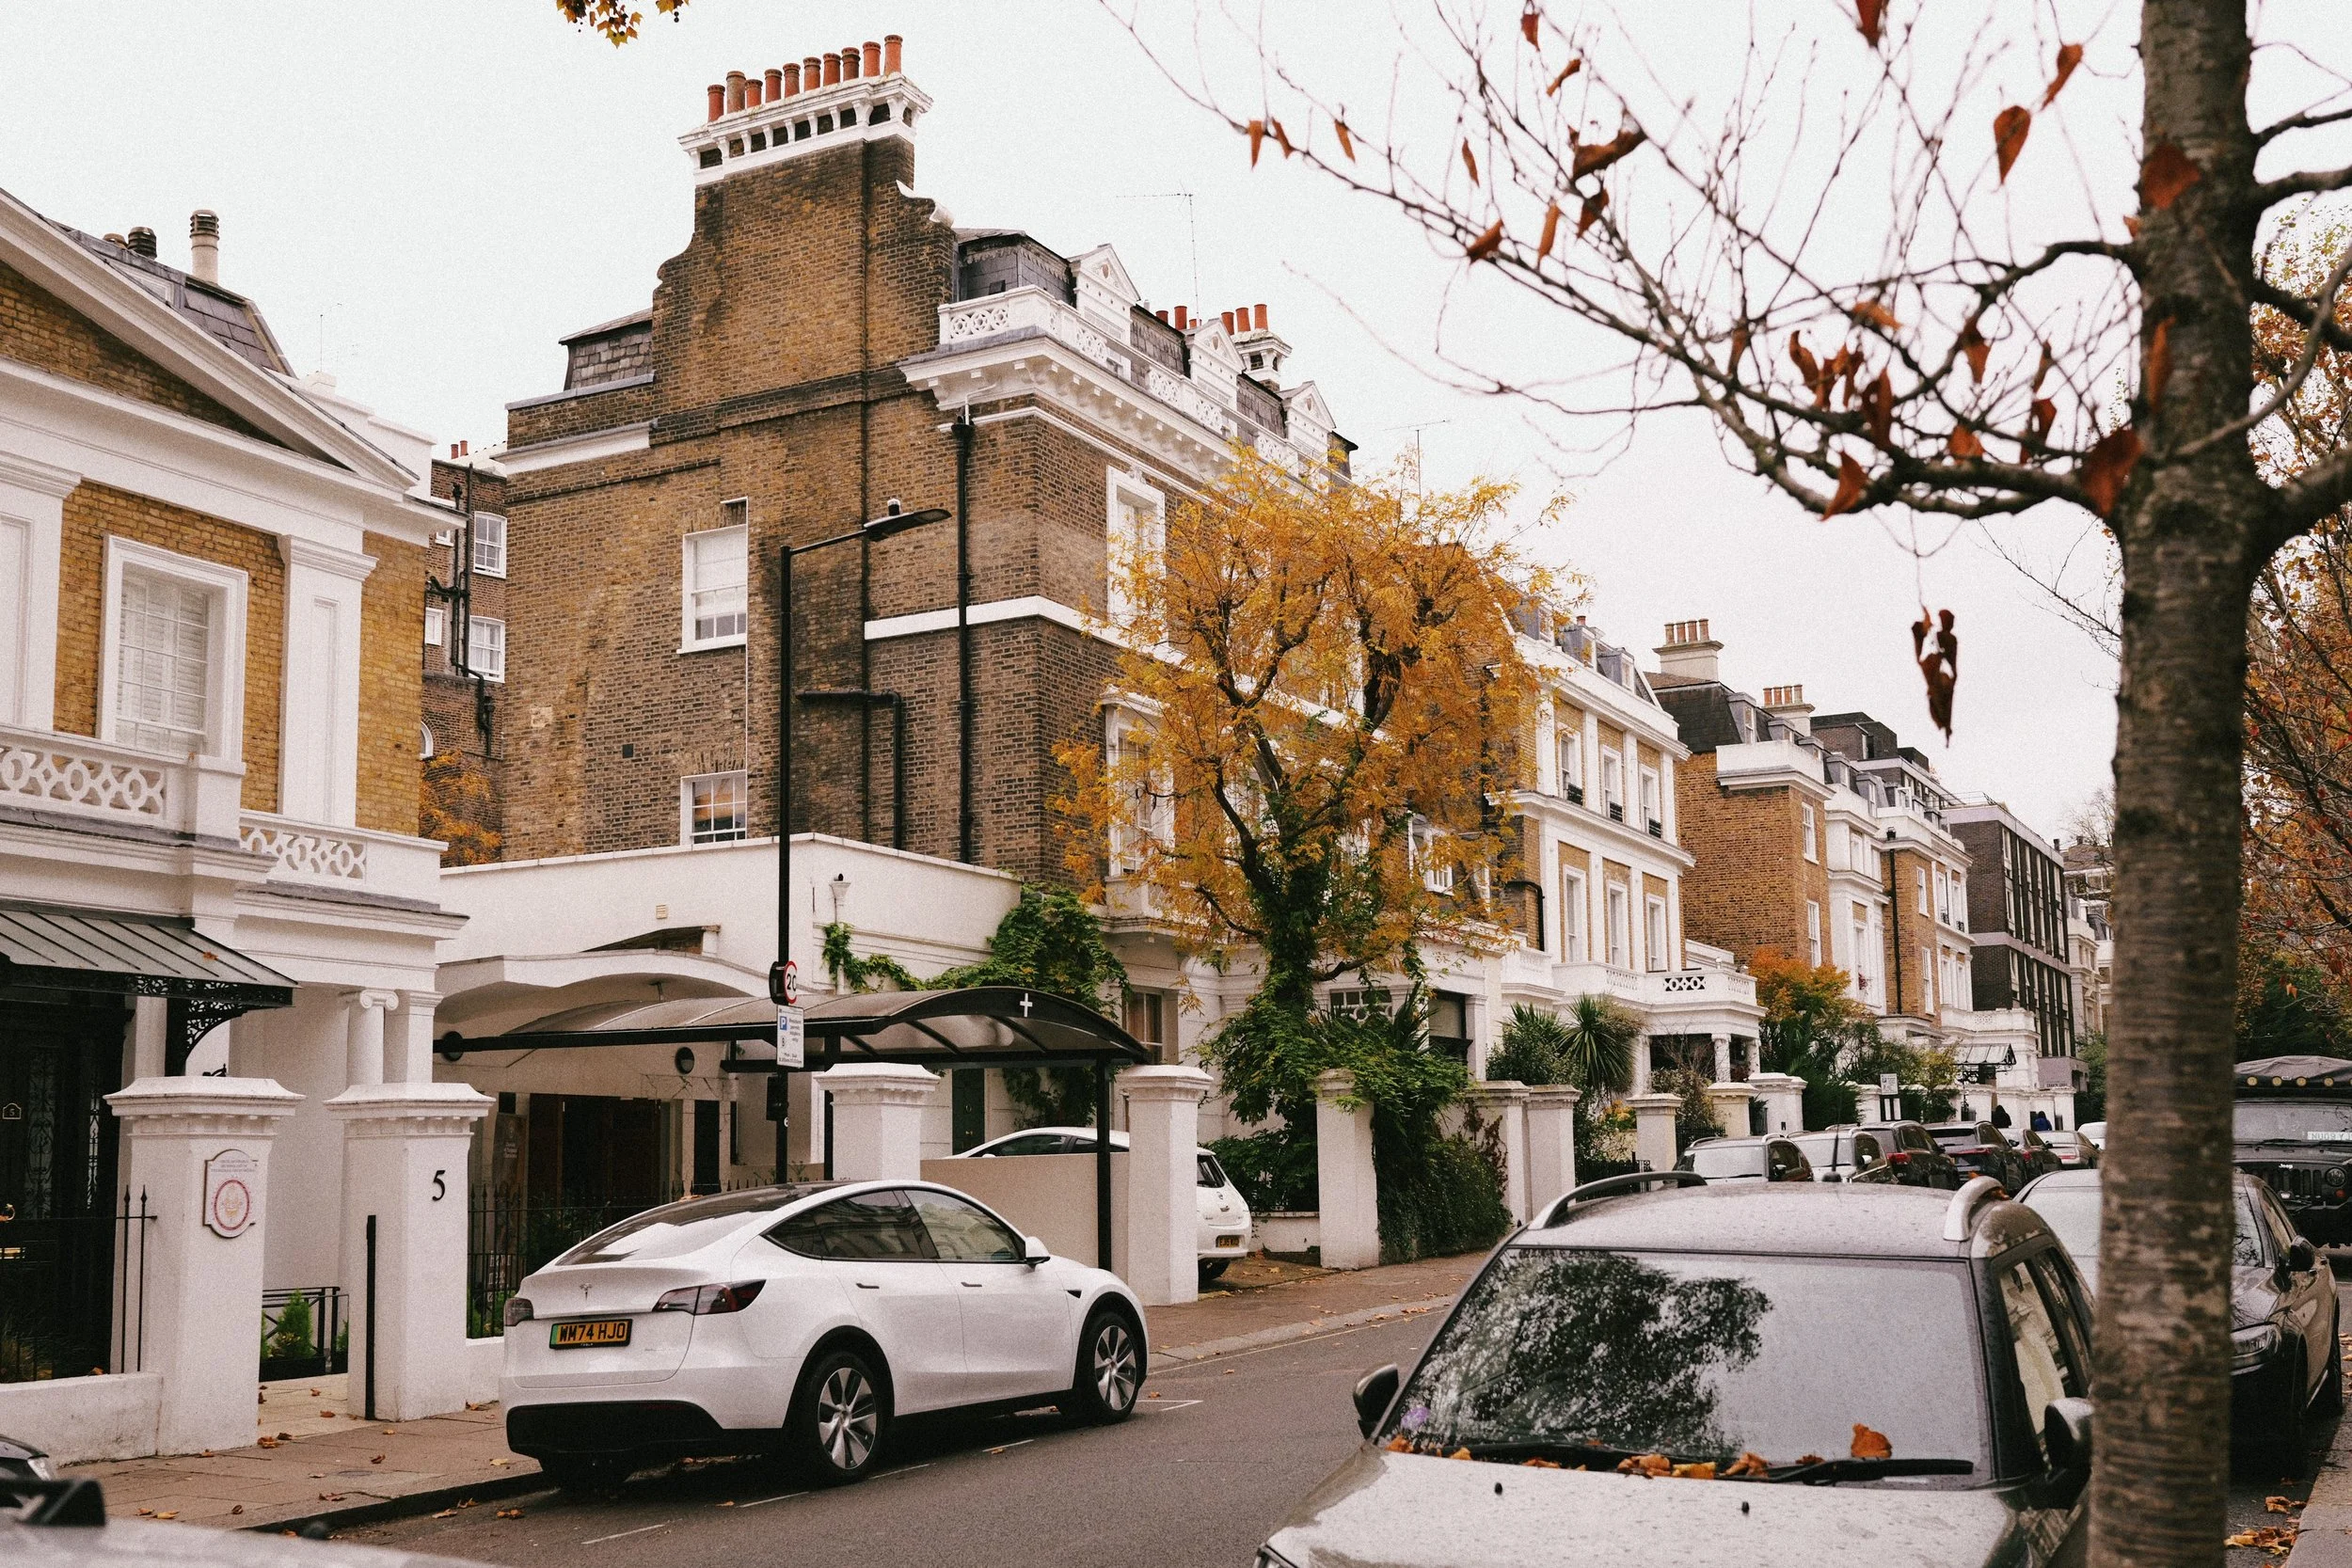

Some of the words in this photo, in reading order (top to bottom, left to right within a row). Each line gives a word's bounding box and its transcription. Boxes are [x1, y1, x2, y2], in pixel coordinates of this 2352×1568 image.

[787, 974, 796, 991] 20
[9, 1108, 15, 1117] 5
[432, 1169, 446, 1202] 5
